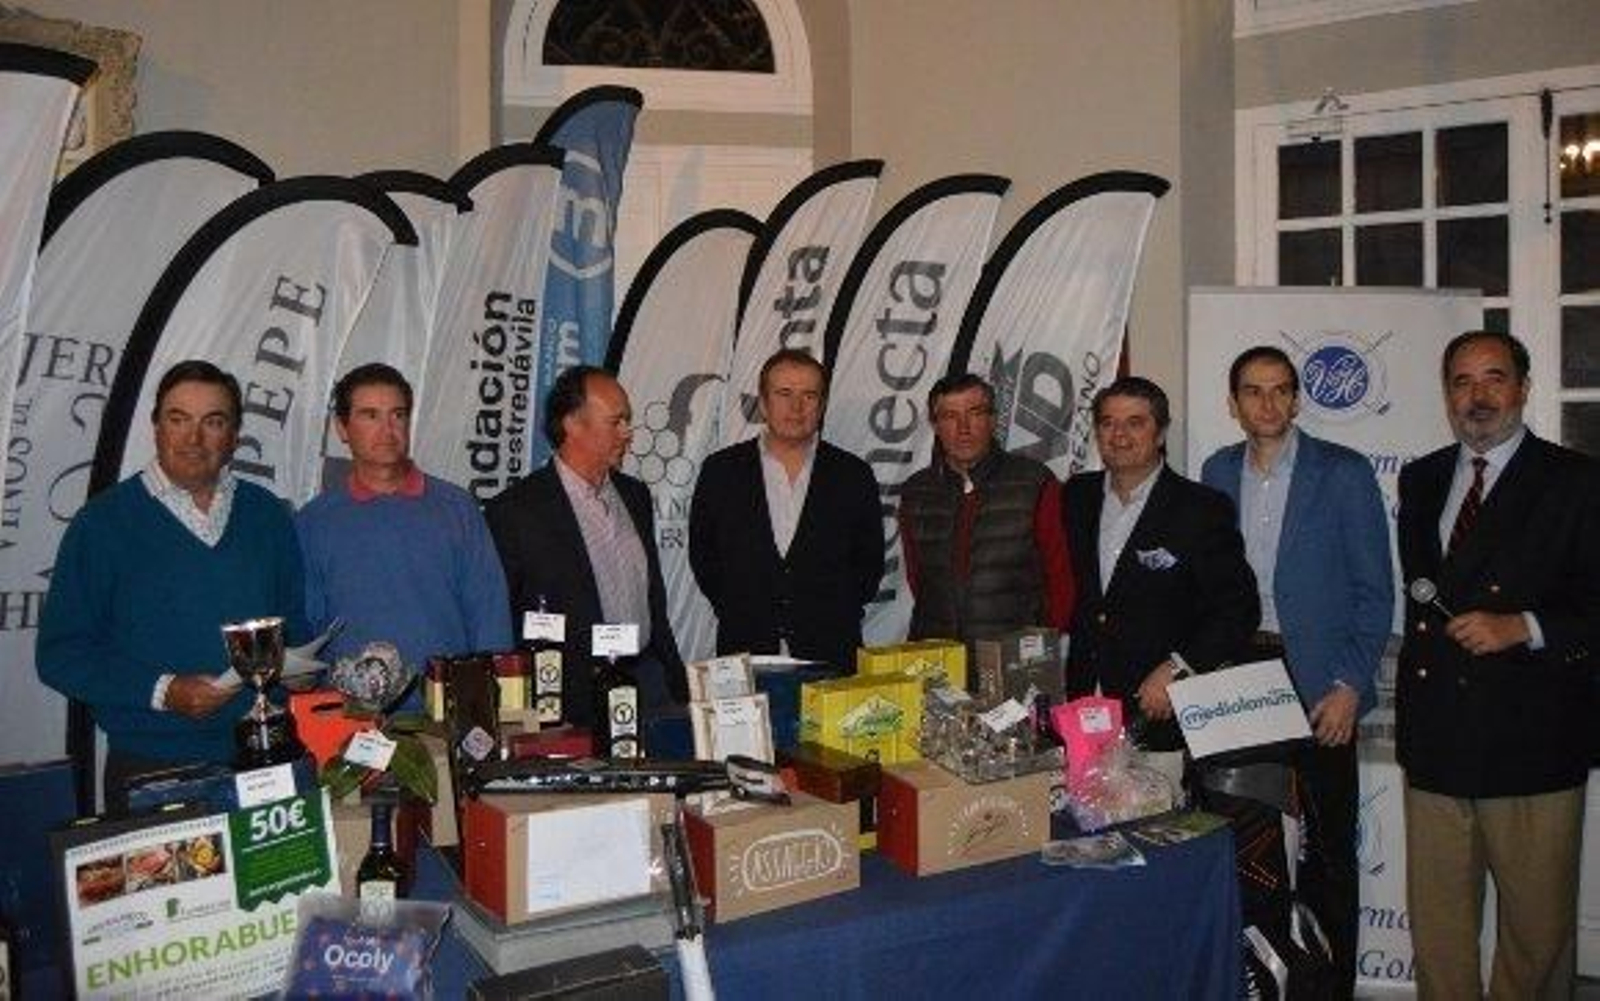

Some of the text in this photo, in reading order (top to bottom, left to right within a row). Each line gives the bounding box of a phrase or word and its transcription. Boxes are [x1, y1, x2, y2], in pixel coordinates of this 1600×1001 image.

[15, 332, 112, 391] JER
[227, 274, 326, 482] PEPE
[466, 290, 513, 500] ndación
[1068, 350, 1101, 474] REZANO
[250, 799, 308, 843] 50€
[85, 908, 298, 991] ENHORABUE
